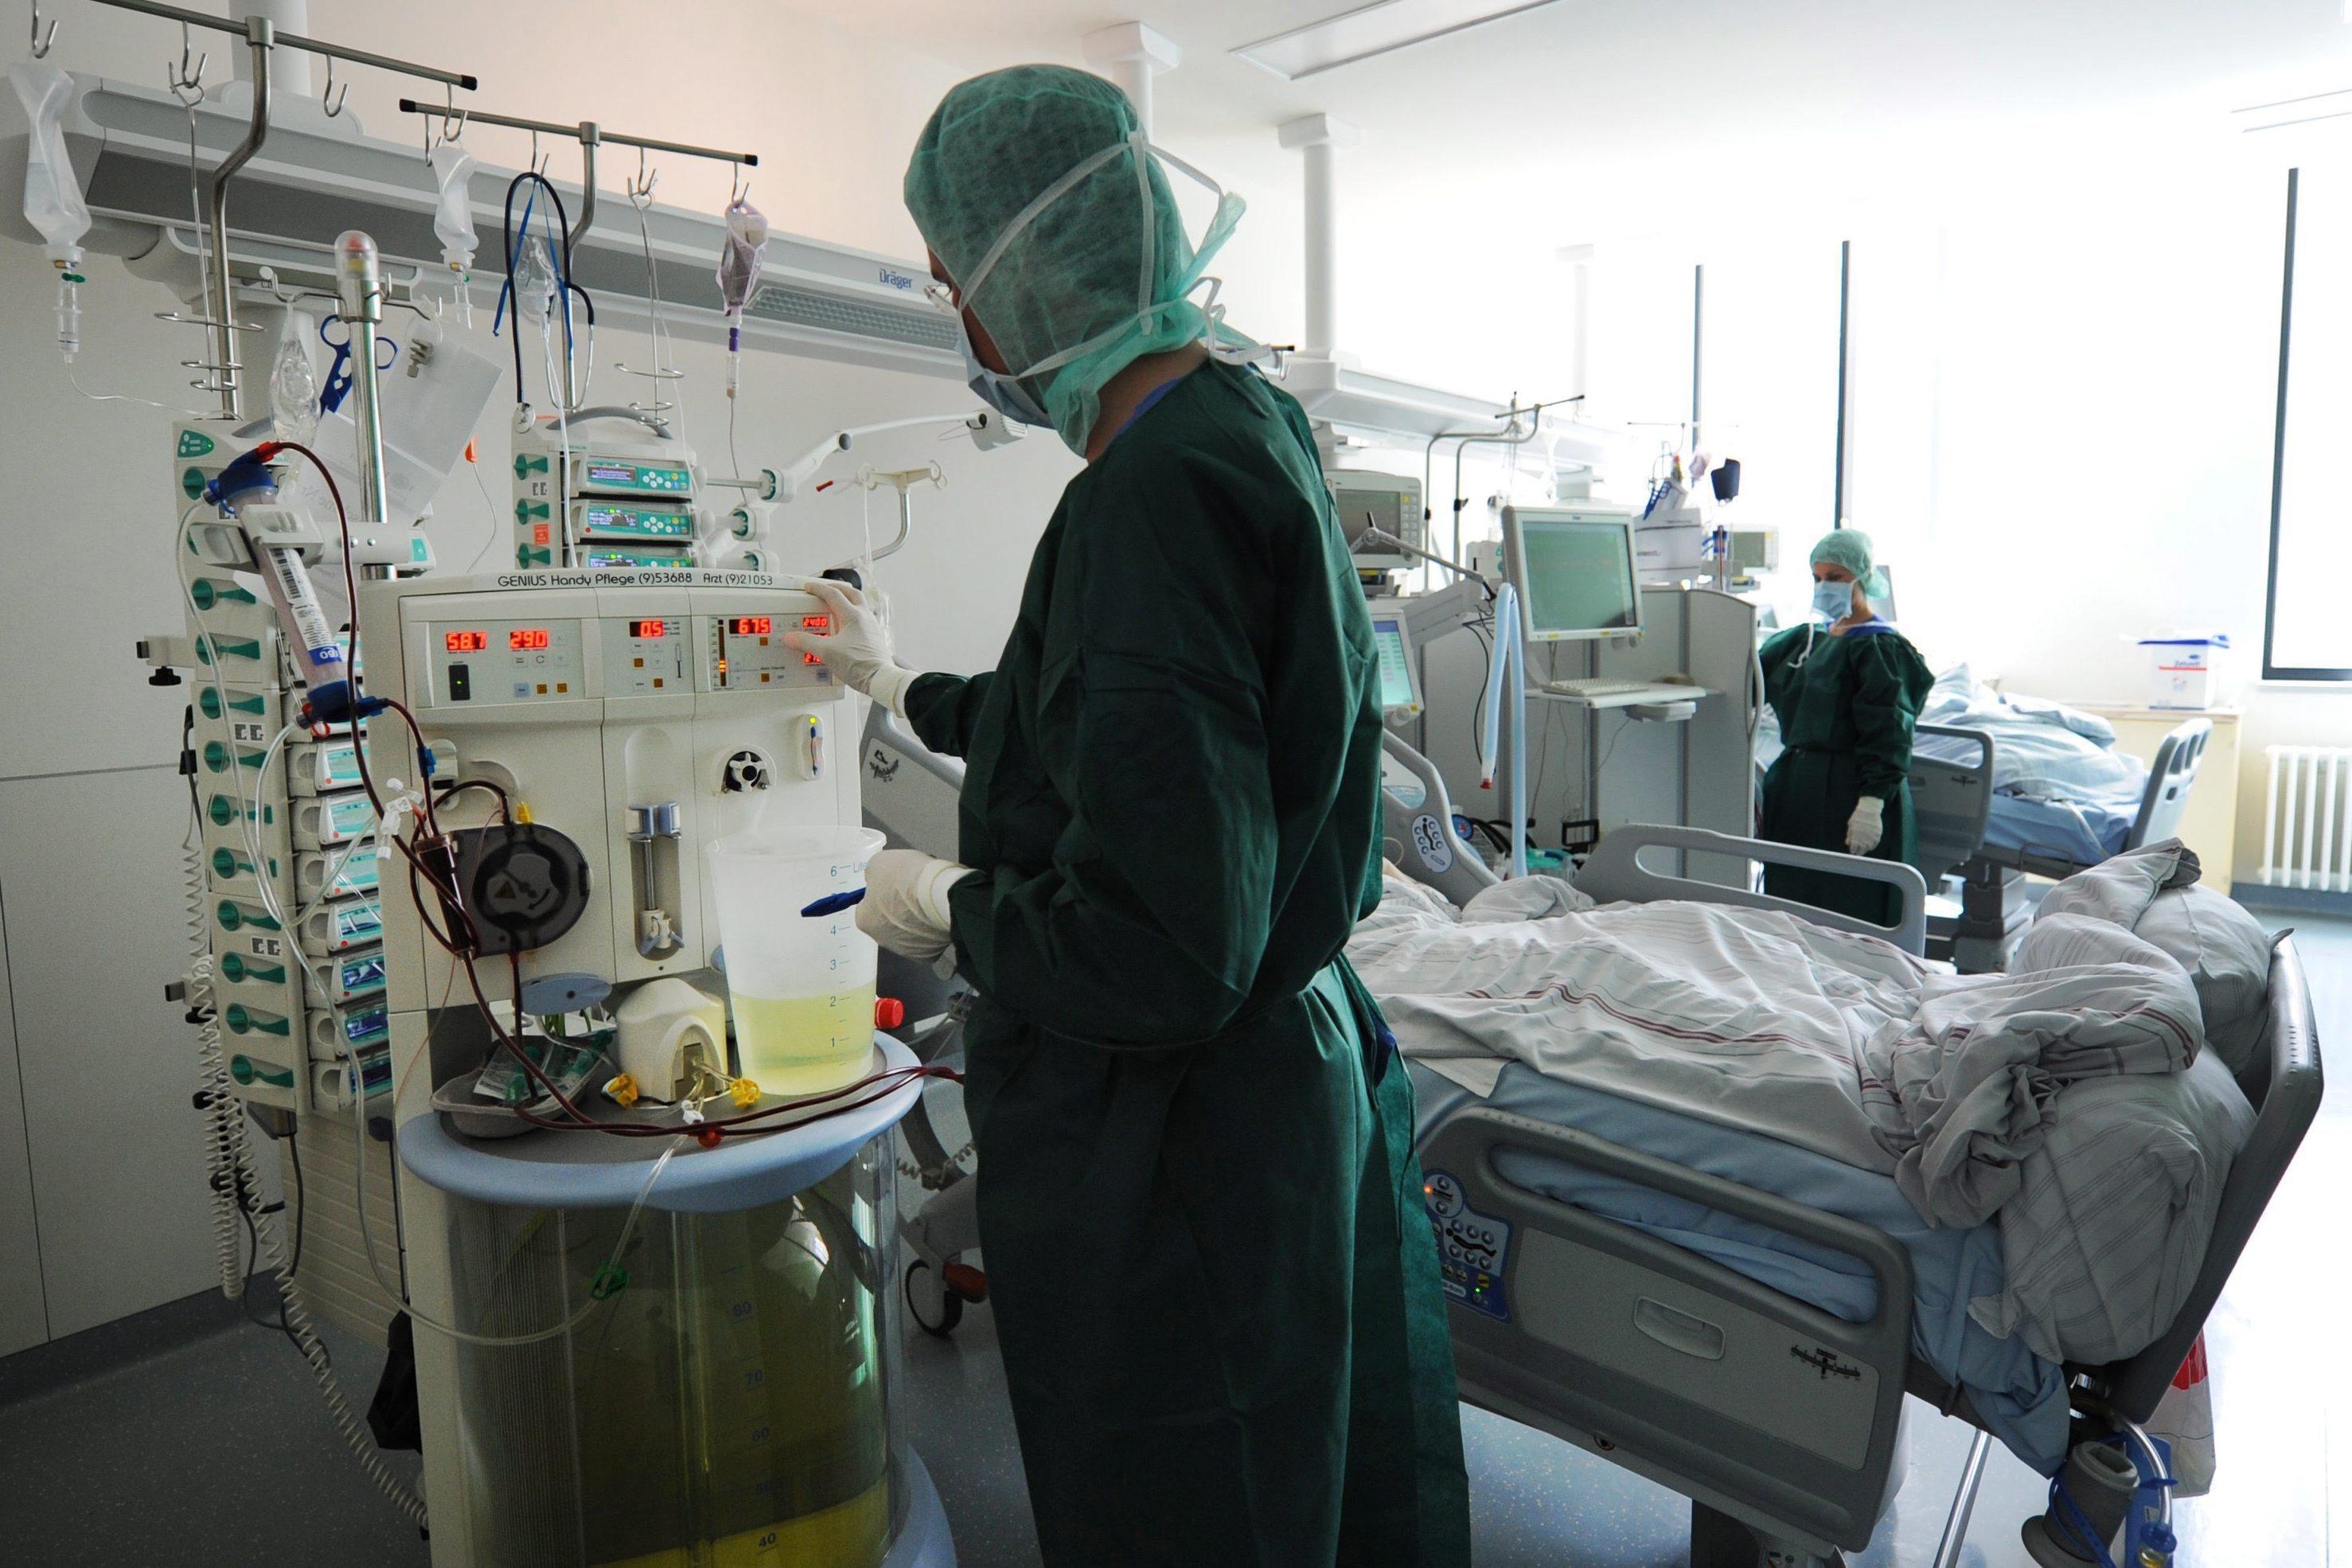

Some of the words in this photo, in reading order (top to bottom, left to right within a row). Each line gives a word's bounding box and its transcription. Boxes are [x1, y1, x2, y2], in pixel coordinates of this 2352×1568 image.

[880, 267, 912, 289] Dräger
[497, 575, 547, 587] GENIUS
[551, 574, 591, 587] Handy
[595, 573, 635, 586] Pflege
[638, 572, 692, 585] (9)53688
[703, 572, 723, 584] Arzt
[725, 573, 773, 586] (9)21053
[510, 630, 548, 648] 290
[830, 865, 837, 877] 6
[852, 861, 869, 873] Lite
[830, 924, 837, 935] 4
[829, 959, 837, 970] 3
[830, 996, 837, 1007] 2
[831, 1037, 835, 1047] 1
[744, 1369, 763, 1385] 70
[759, 1532, 776, 1548] 40
